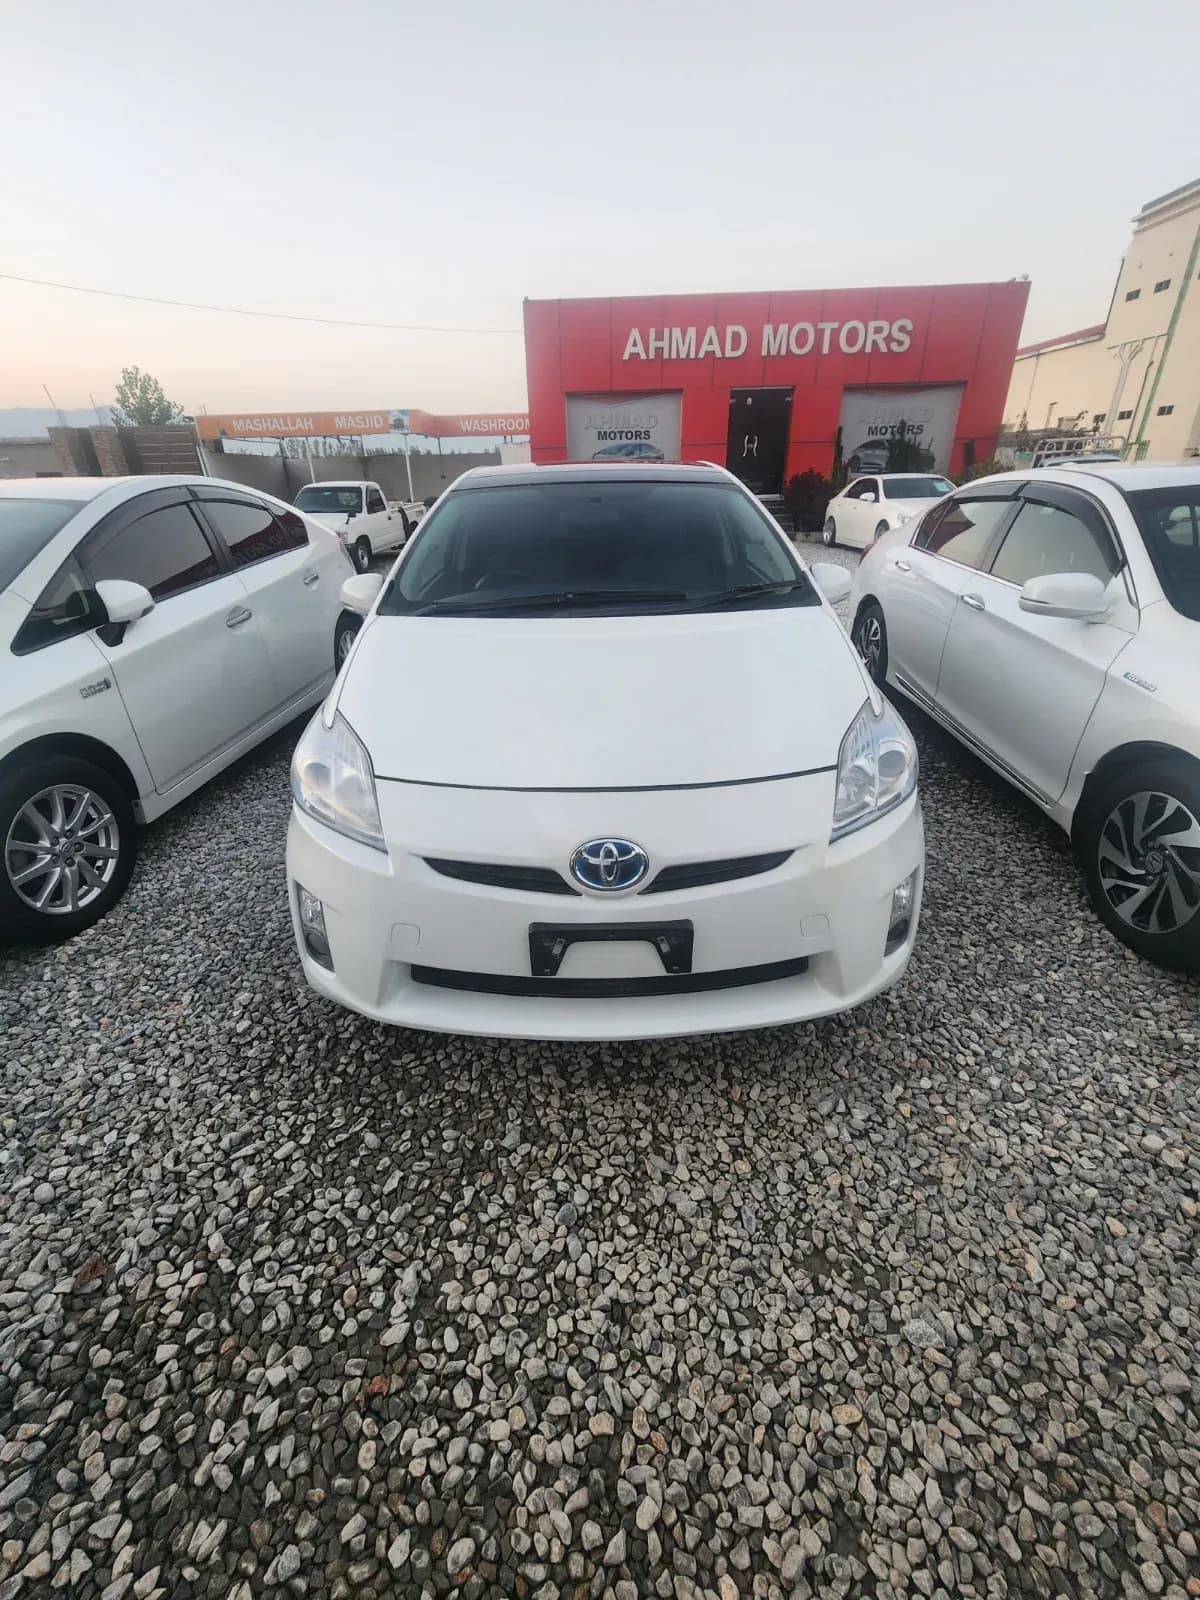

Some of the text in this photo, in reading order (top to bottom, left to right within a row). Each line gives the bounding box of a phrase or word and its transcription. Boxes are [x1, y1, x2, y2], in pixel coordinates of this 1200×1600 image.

[622, 318, 914, 361] AHMAD MOTORS
[232, 414, 383, 432] MASHALLAH MASJID
[583, 413, 658, 430] AHMAD
[597, 429, 651, 441] MOTORS
